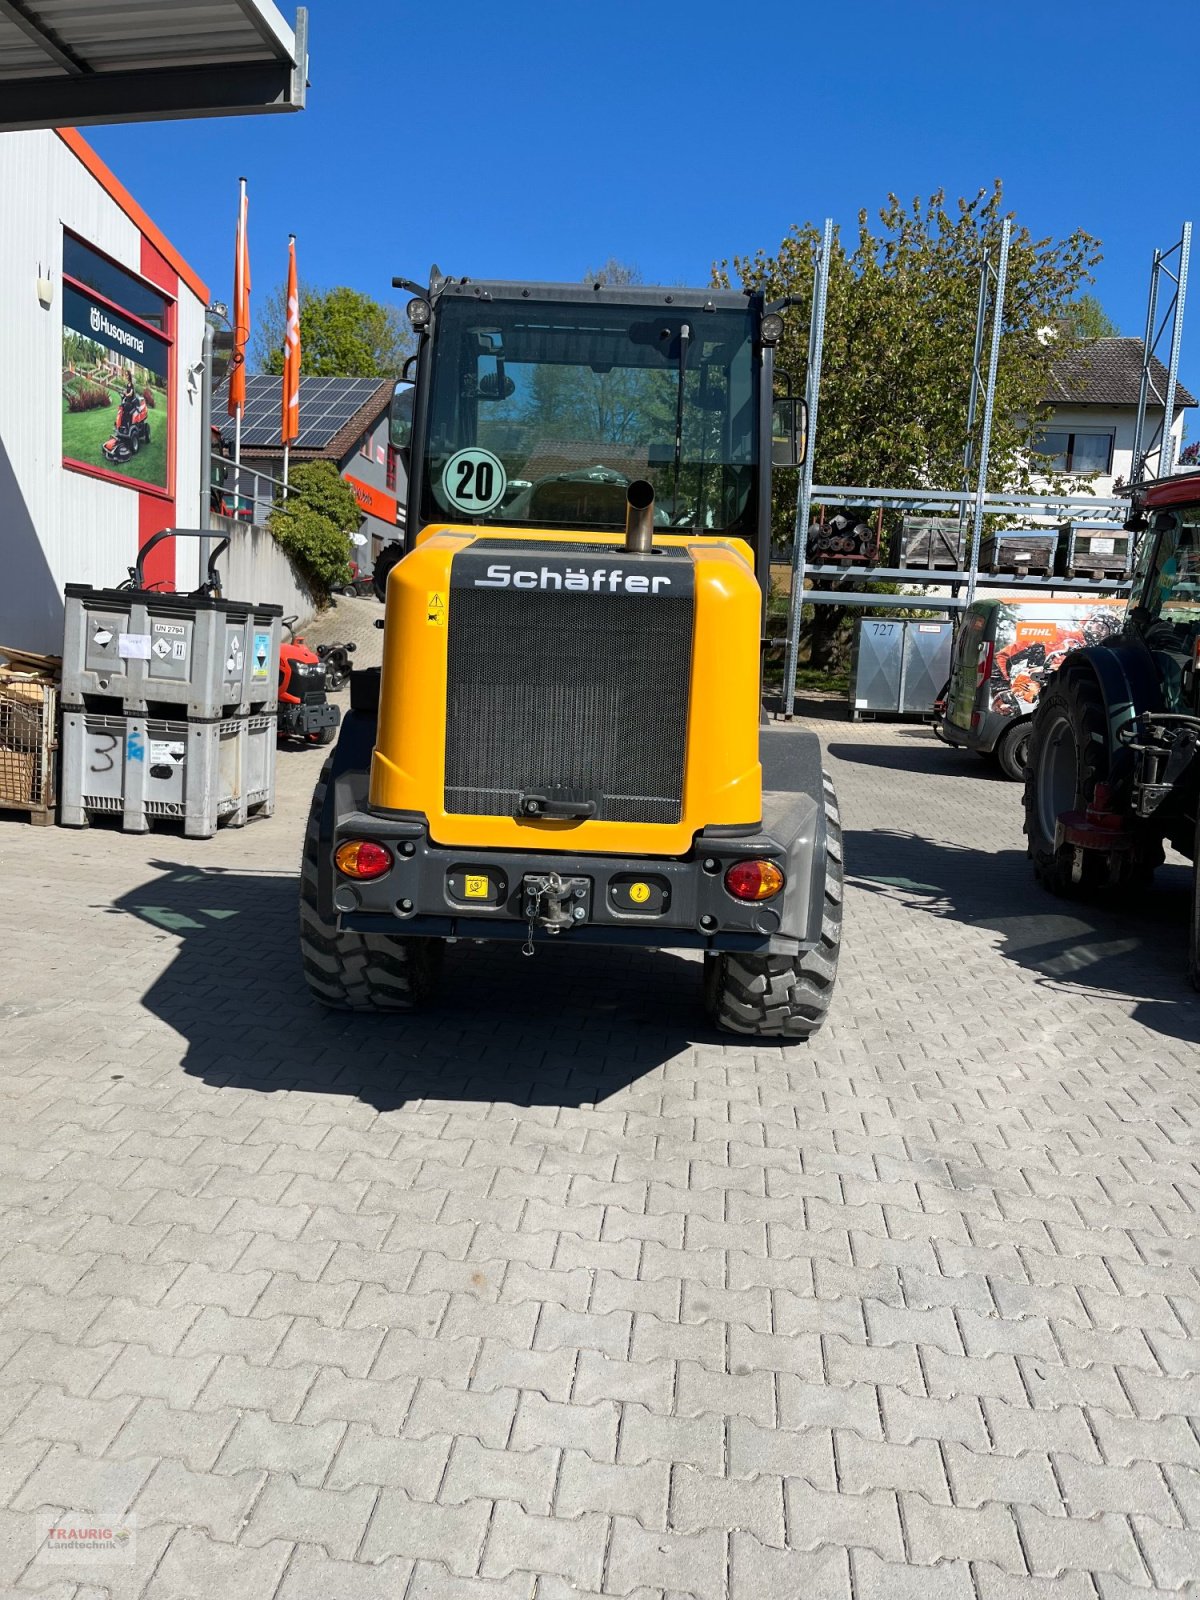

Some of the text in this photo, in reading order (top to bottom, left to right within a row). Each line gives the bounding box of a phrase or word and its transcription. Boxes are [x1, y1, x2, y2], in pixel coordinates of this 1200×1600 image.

[100, 314, 144, 354] Husqvarna
[456, 460, 494, 501] 20
[474, 564, 672, 594] Schäffer
[872, 623, 895, 636] 727
[1020, 627, 1052, 637] STIHL
[90, 731, 118, 772] 3
